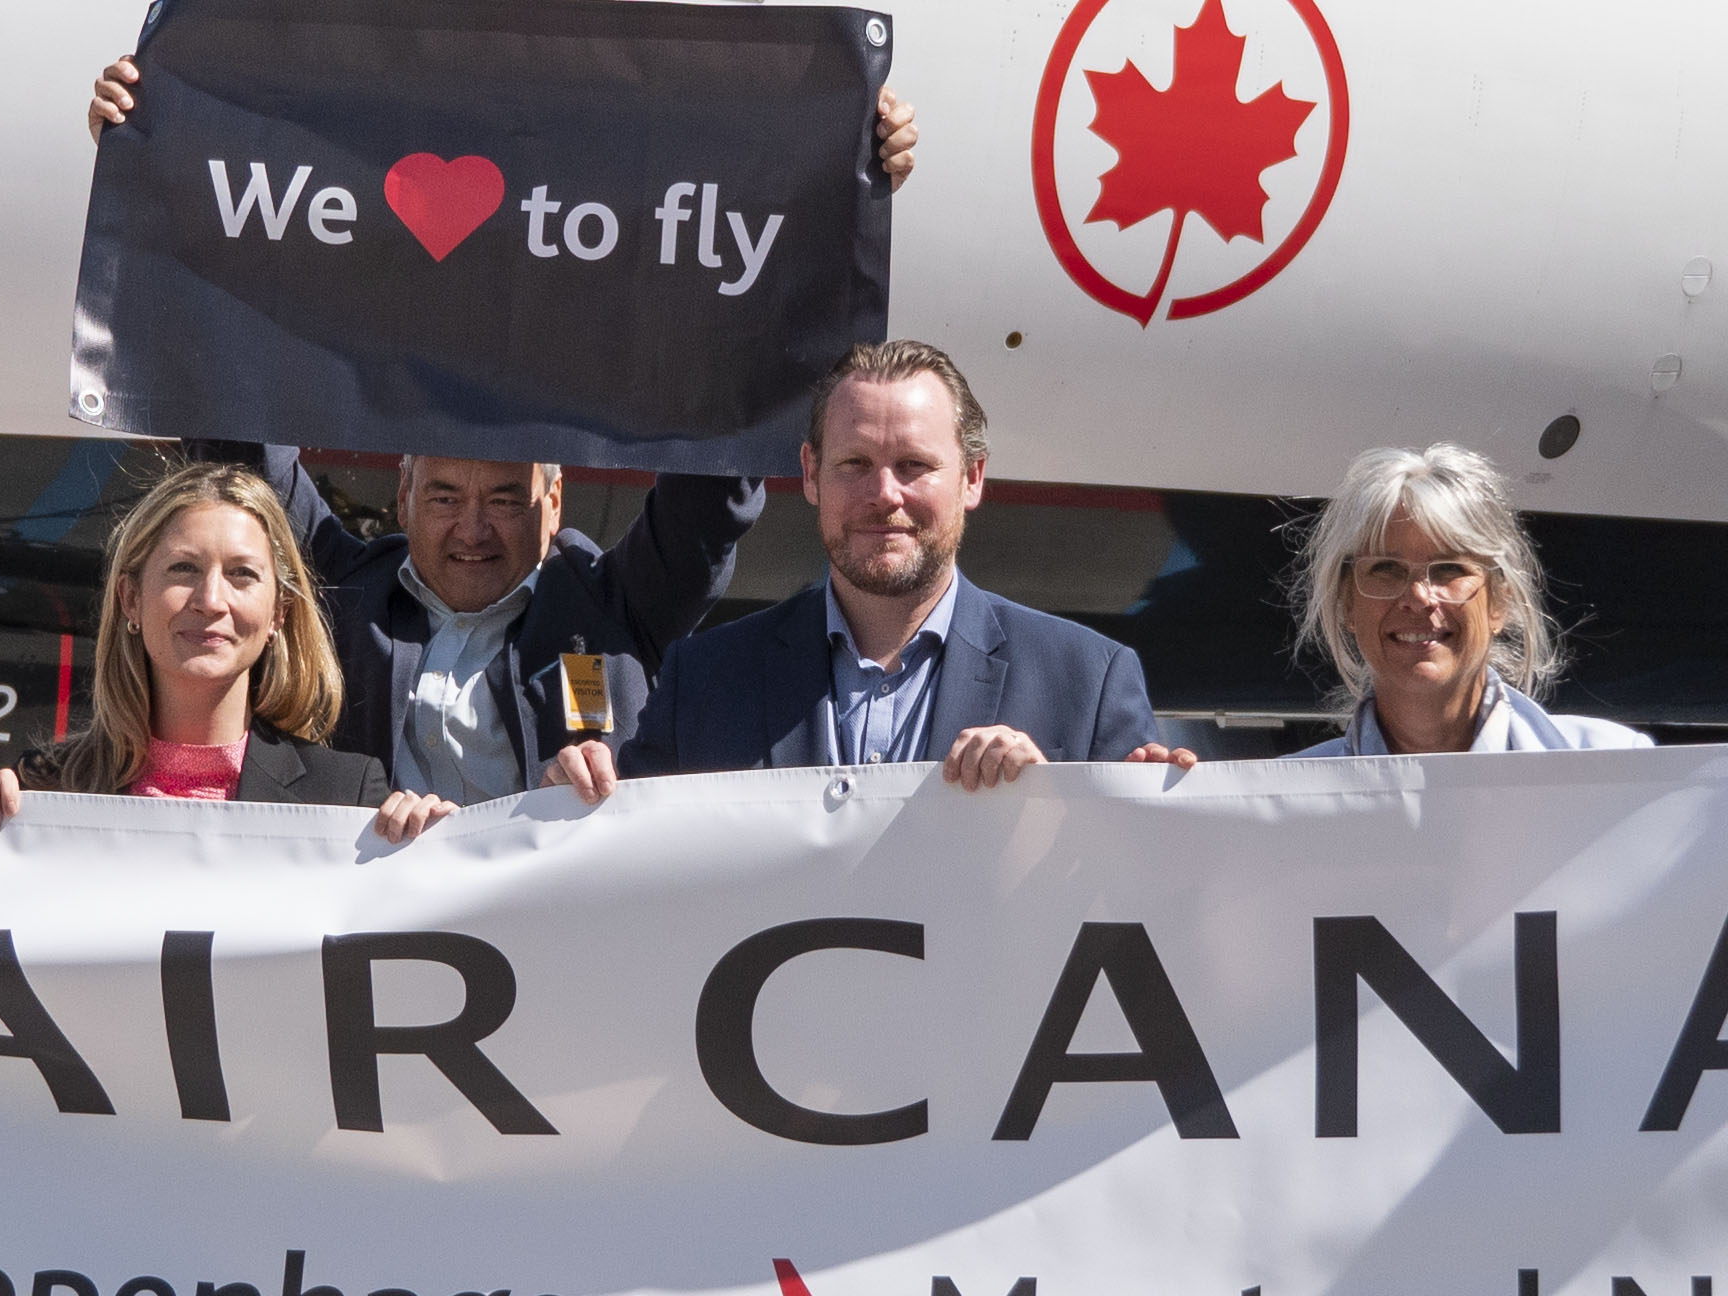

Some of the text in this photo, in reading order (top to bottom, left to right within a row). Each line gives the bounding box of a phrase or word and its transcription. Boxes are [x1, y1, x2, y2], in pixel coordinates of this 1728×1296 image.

[206, 158, 786, 297] We to fly
[573, 686, 605, 697] VISITOR
